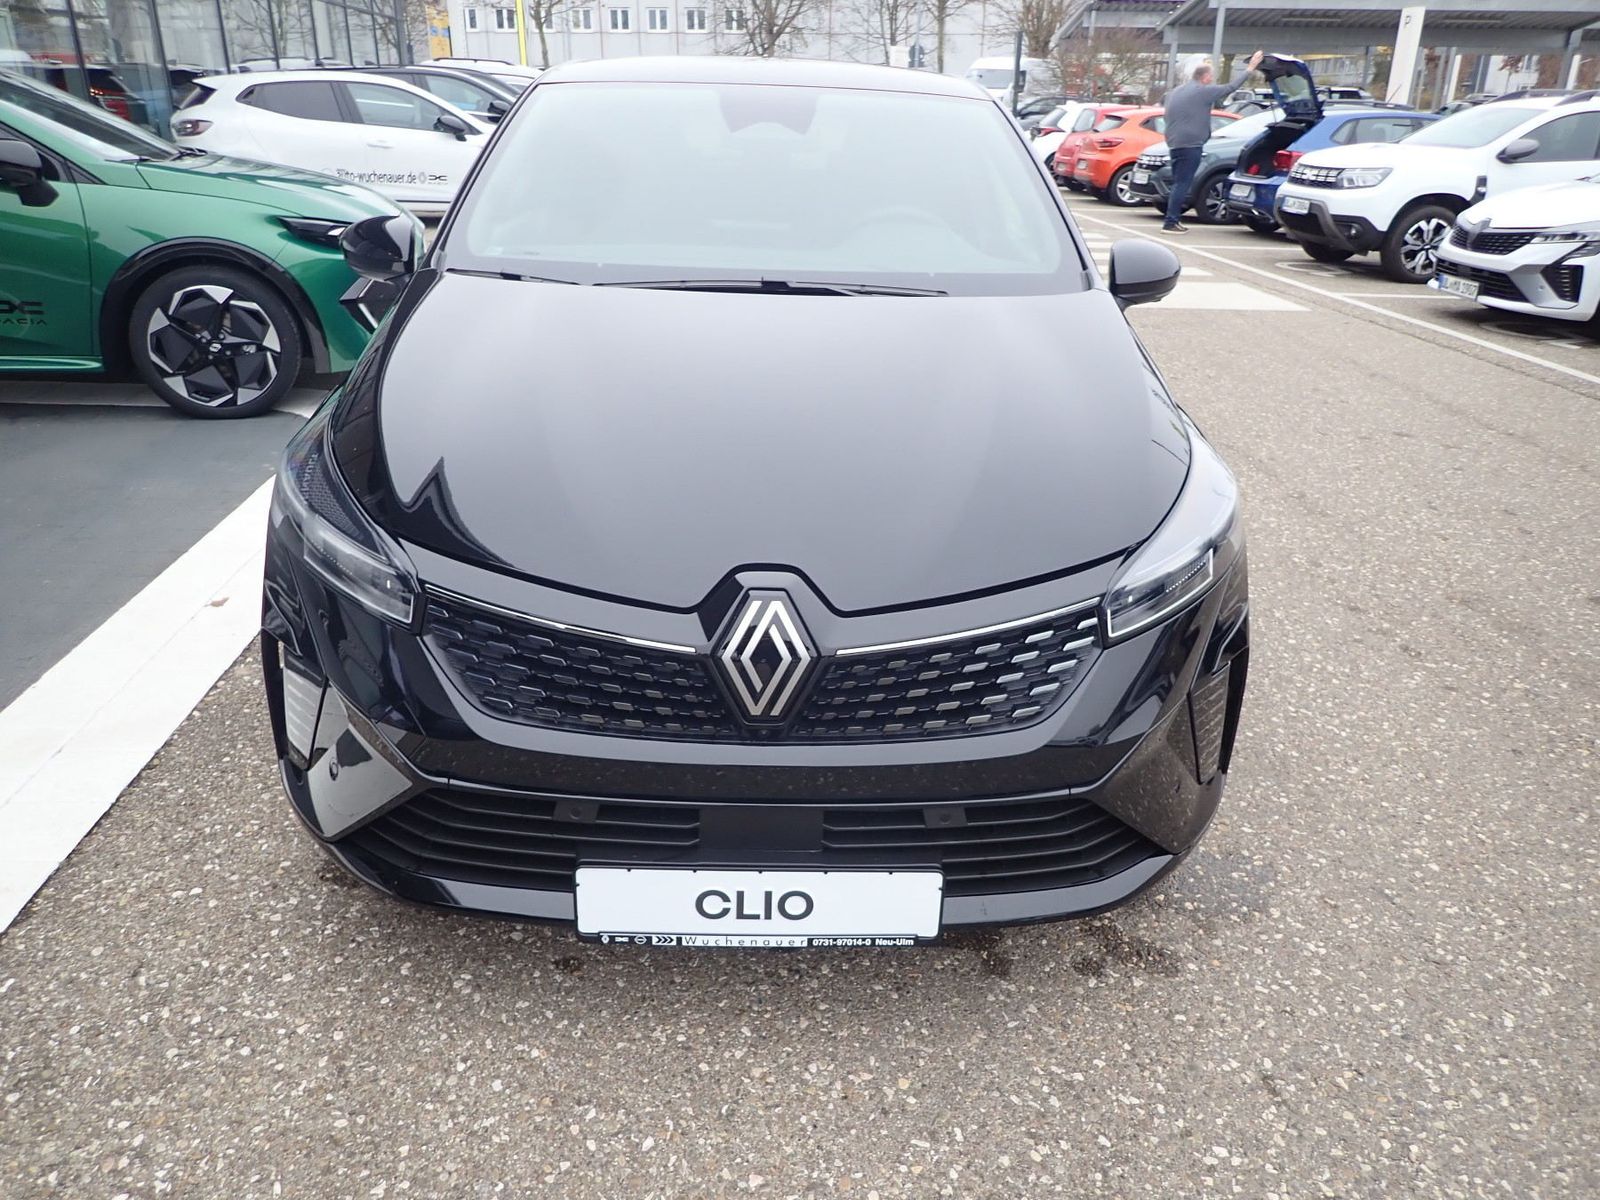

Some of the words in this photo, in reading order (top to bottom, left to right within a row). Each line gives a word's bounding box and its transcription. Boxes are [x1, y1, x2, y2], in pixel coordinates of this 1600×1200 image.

[1, 318, 48, 326] ACIA
[695, 889, 814, 921] CLIO
[684, 935, 806, 947] Wuchenauer
[812, 938, 872, 947] 0731-97014-0
[875, 938, 914, 947] Neu-Ulm
